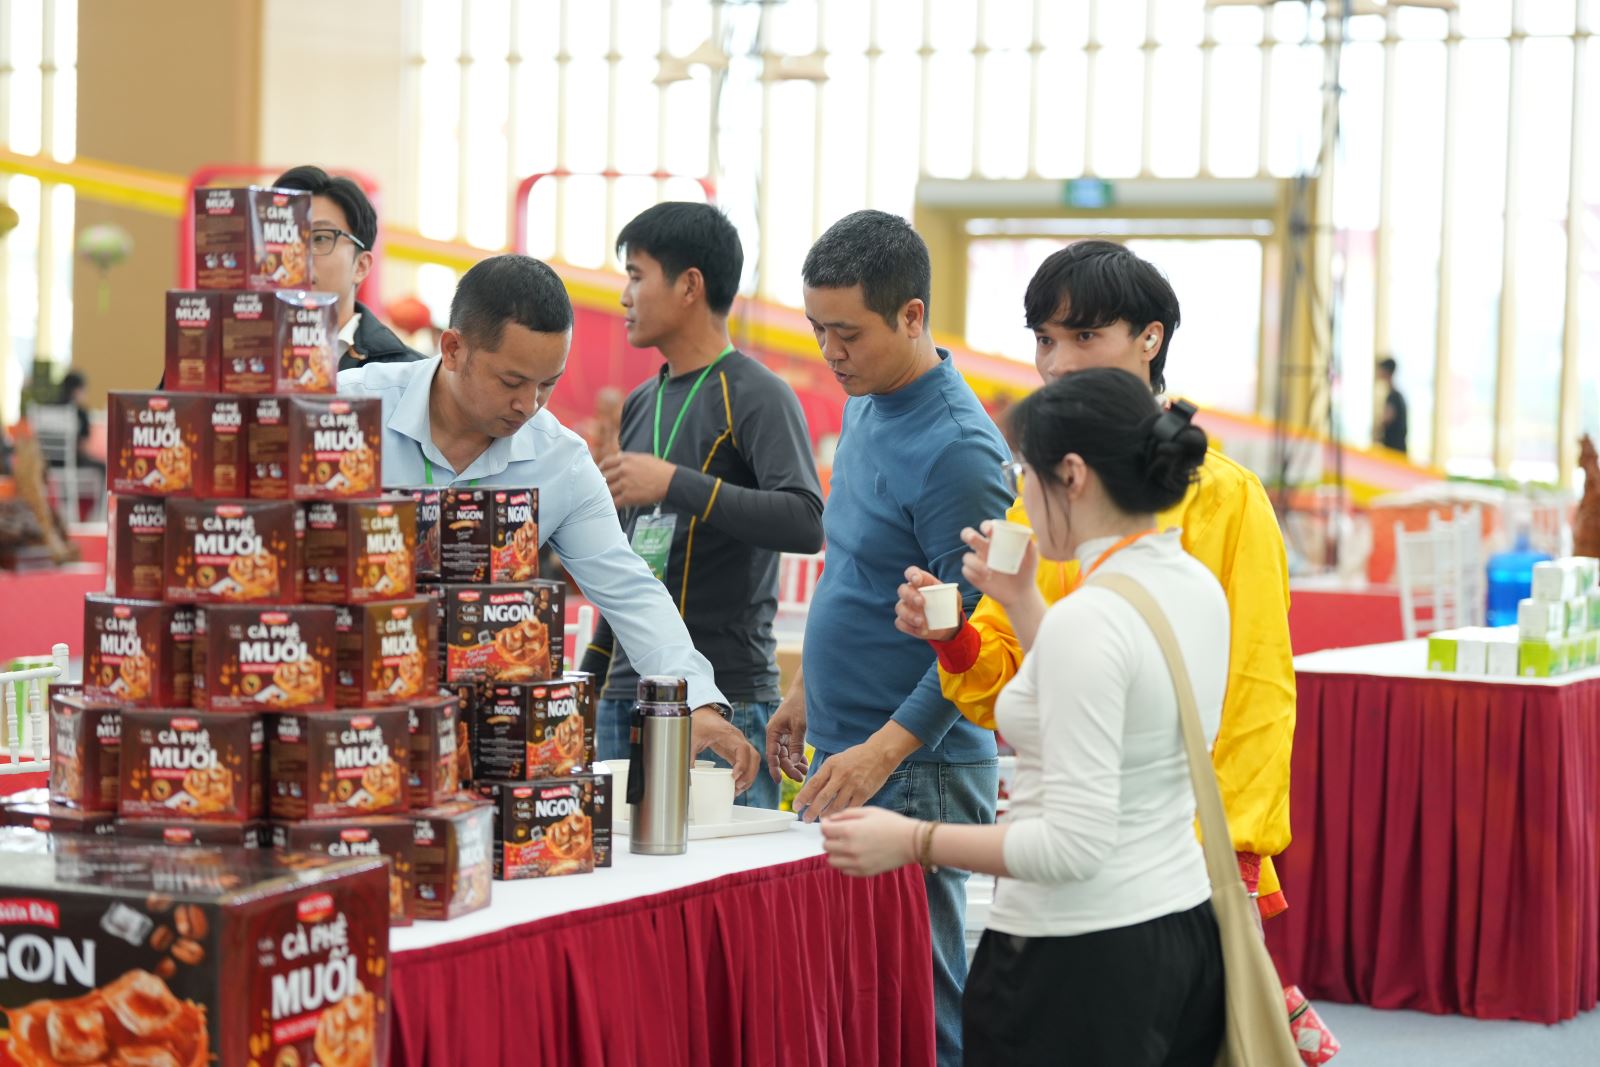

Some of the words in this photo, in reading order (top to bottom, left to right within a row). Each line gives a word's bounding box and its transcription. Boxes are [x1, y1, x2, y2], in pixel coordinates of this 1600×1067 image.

[456, 510, 484, 520] NGON
[507, 506, 531, 523] NGON
[195, 528, 262, 556] MUỐI
[483, 604, 535, 622] NGON
[239, 636, 307, 663] MUỐI
[494, 705, 520, 716] NGON
[547, 698, 577, 718] NGON
[96, 724, 120, 738] MU
[150, 743, 217, 769] MUỐI
[535, 798, 580, 818] NGON
[281, 922, 309, 960] CÀ
[310, 911, 348, 953] PHÊ
[0, 933, 96, 989] ON
[271, 946, 357, 1020] MUỐI
